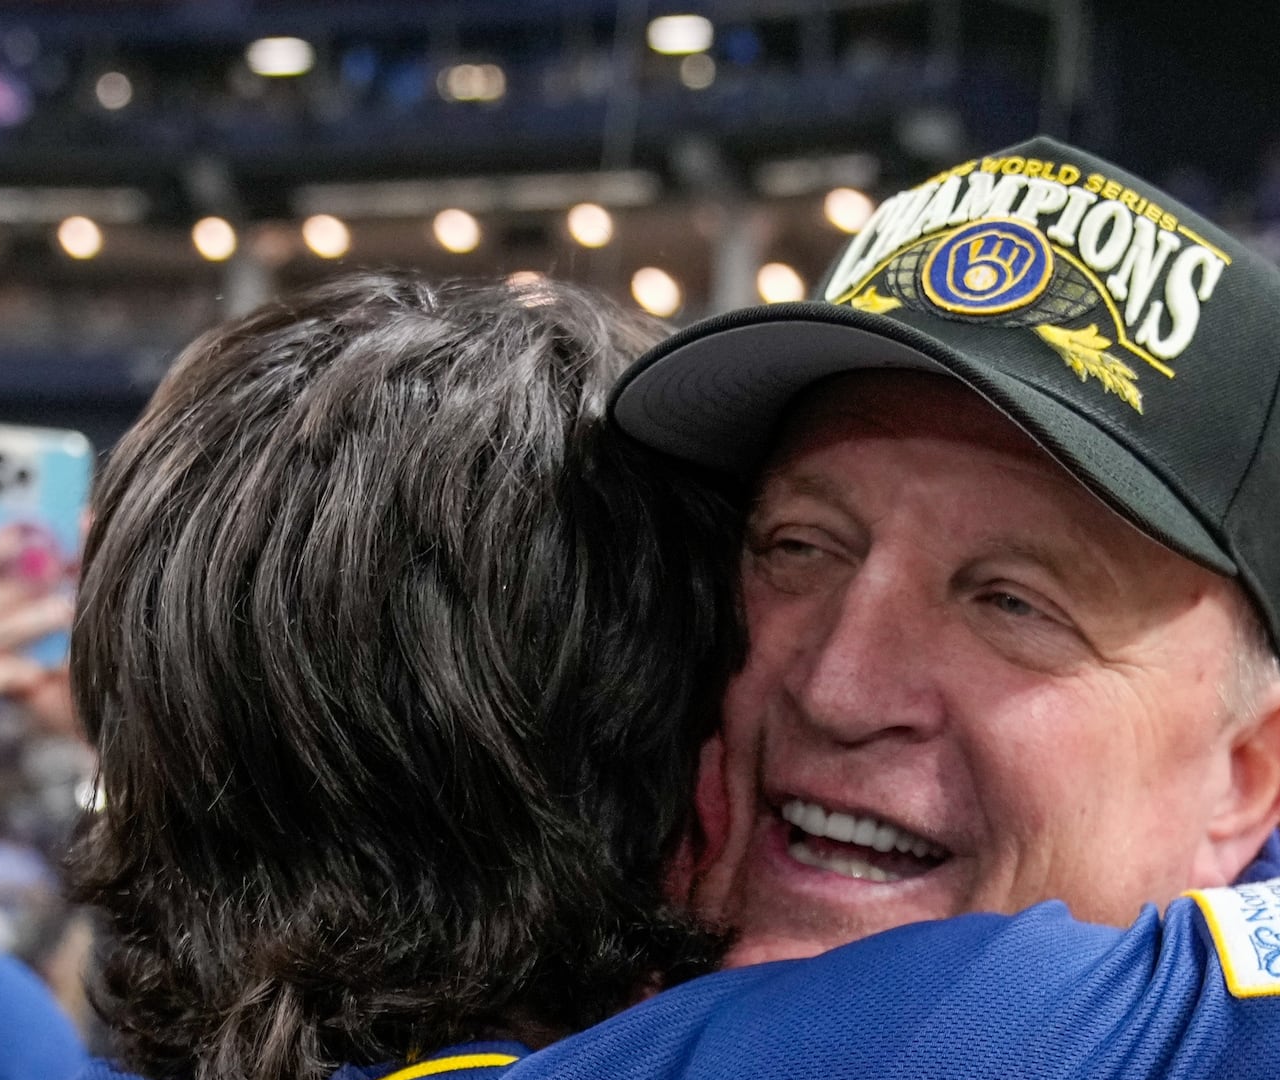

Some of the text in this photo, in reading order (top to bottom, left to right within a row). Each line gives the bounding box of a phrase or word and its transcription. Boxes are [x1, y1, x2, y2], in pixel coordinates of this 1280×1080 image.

[980, 155, 1081, 186] WORLD
[1084, 173, 1179, 232] SERIES
[825, 171, 1224, 361] CHAMPIONS
